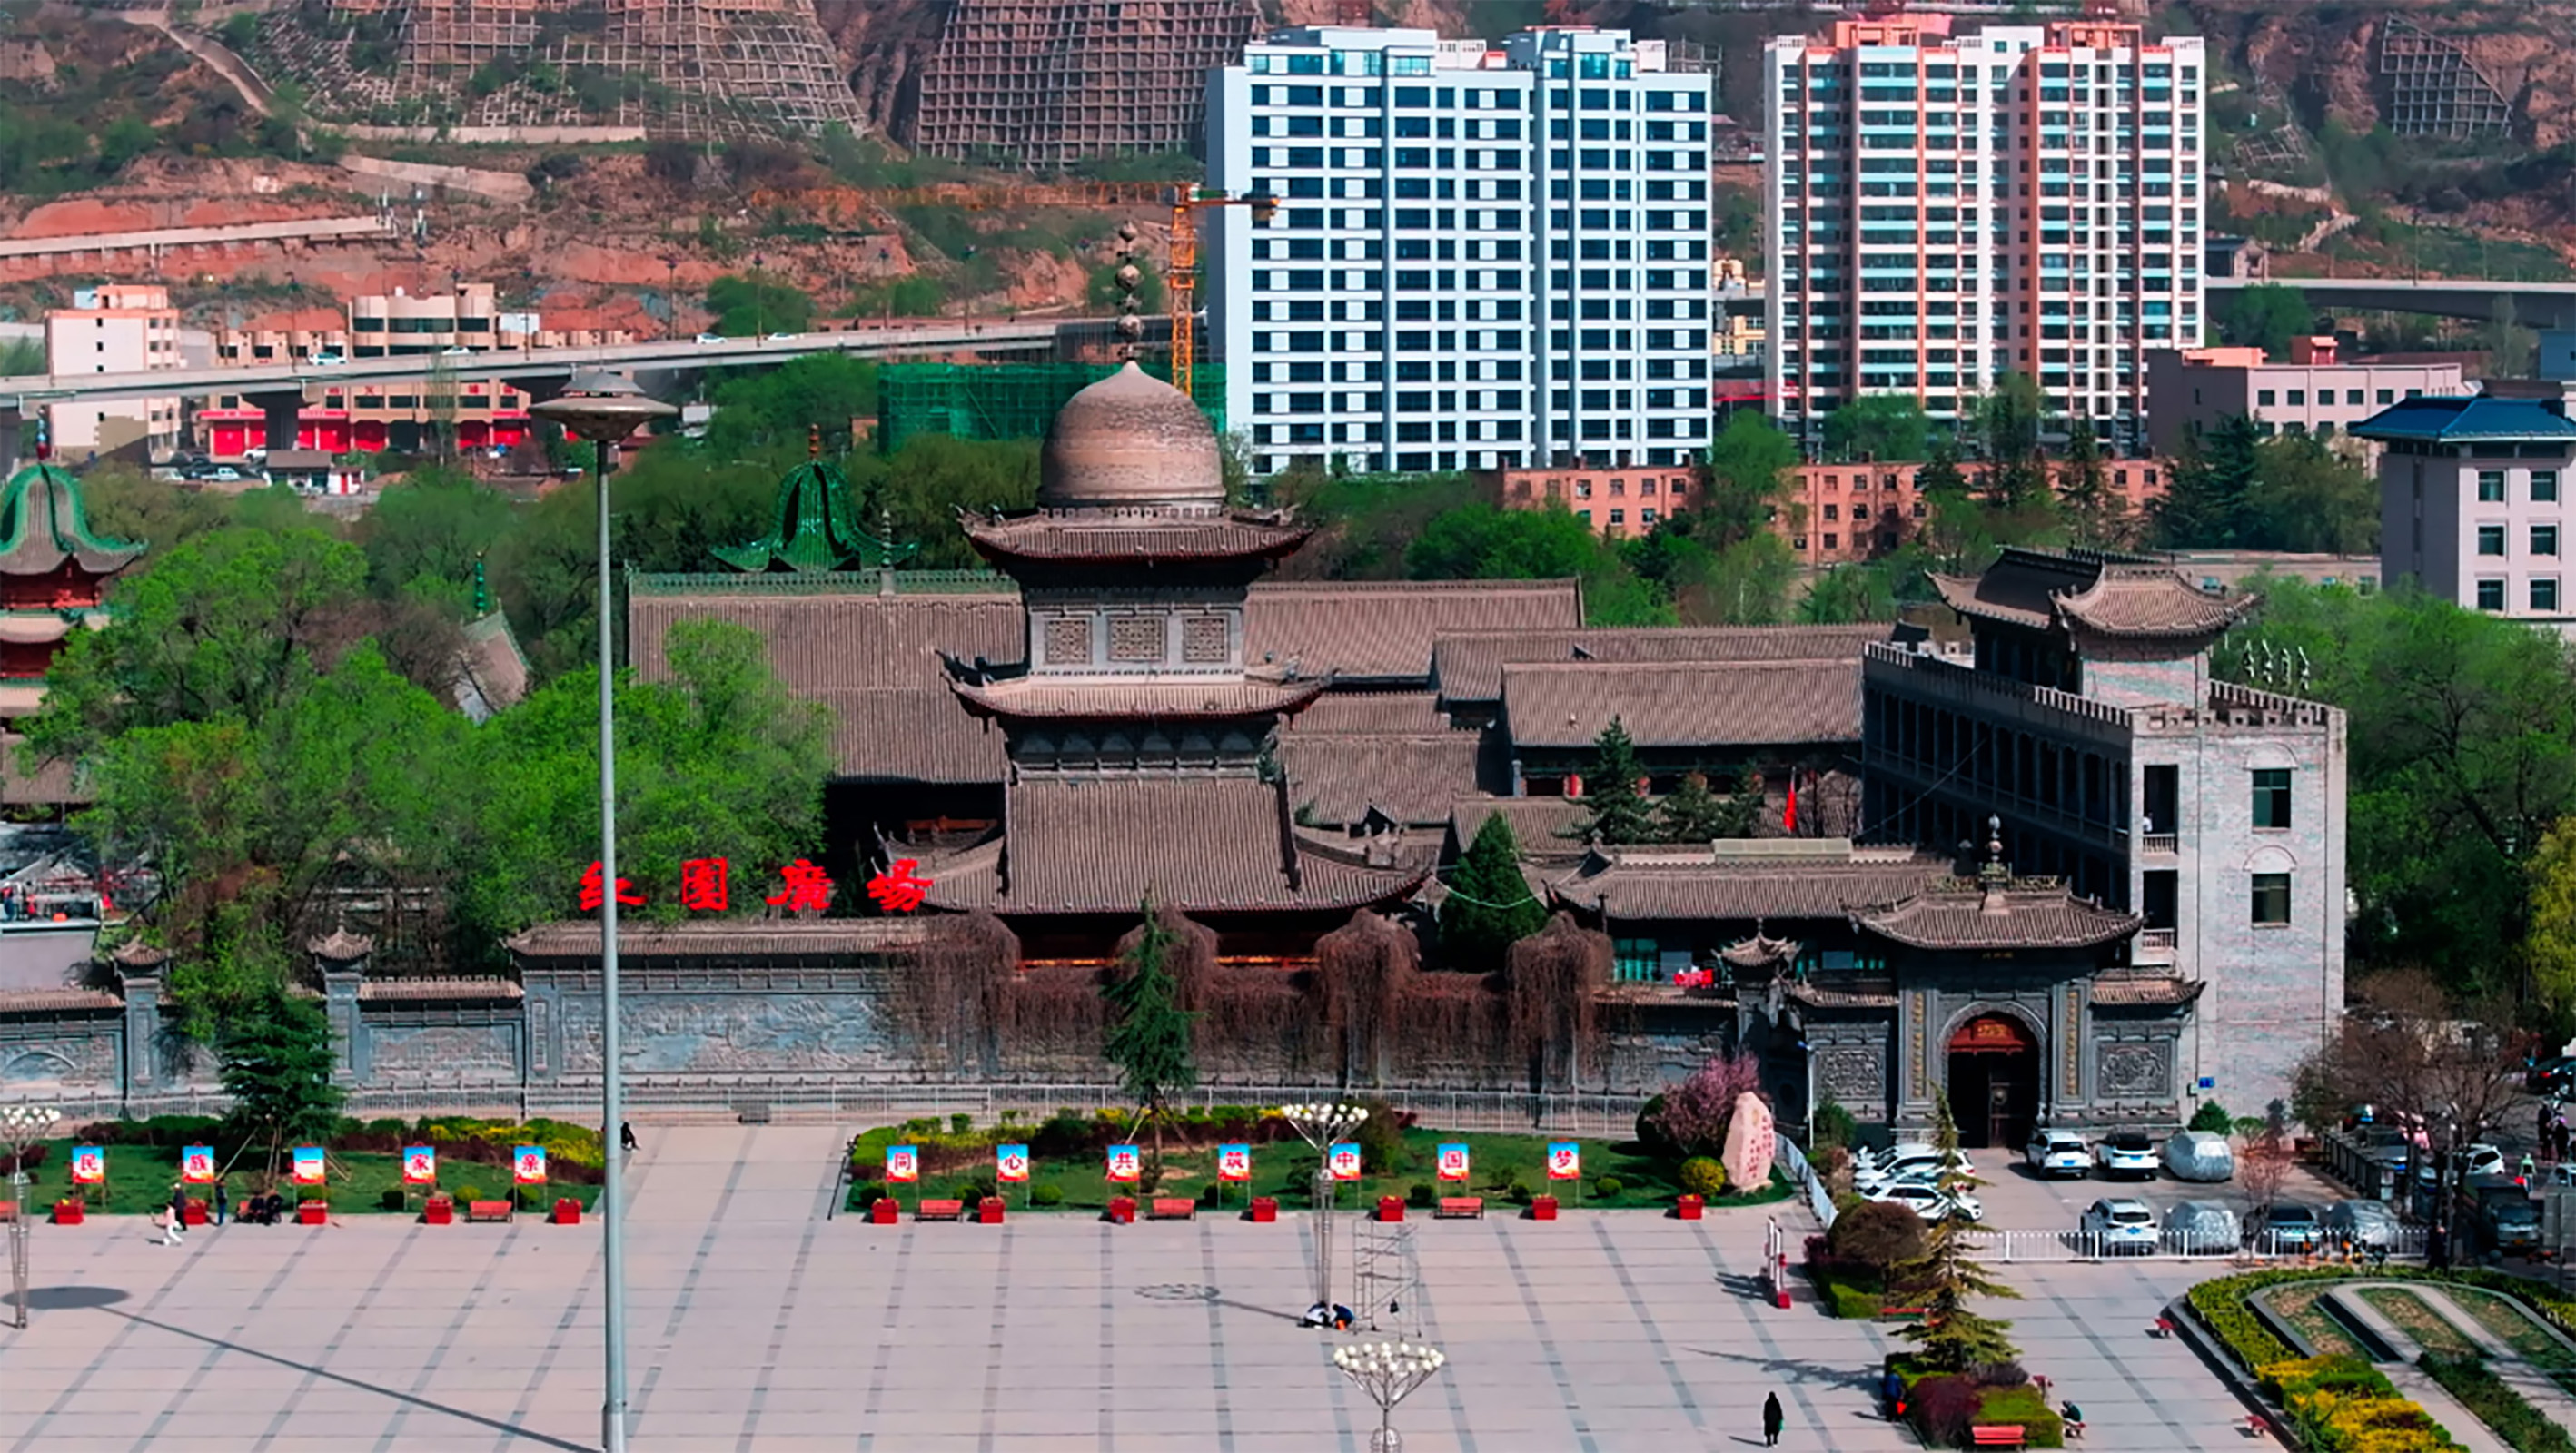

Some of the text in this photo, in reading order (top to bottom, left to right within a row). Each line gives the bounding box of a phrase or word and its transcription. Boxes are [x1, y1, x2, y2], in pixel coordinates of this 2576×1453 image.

[80, 1154, 98, 1171] 民
[190, 1154, 207, 1171] 族
[411, 1154, 429, 1171] 家
[521, 1154, 539, 1172] 亲
[895, 1152, 911, 1171] 同
[1004, 1152, 1024, 1171] 心
[1114, 1152, 1134, 1171] 共
[1226, 1152, 1243, 1169] 筑
[1337, 1151, 1354, 1168] 中
[1444, 1150, 1463, 1169] 国
[1554, 1150, 1573, 1169] 梦
